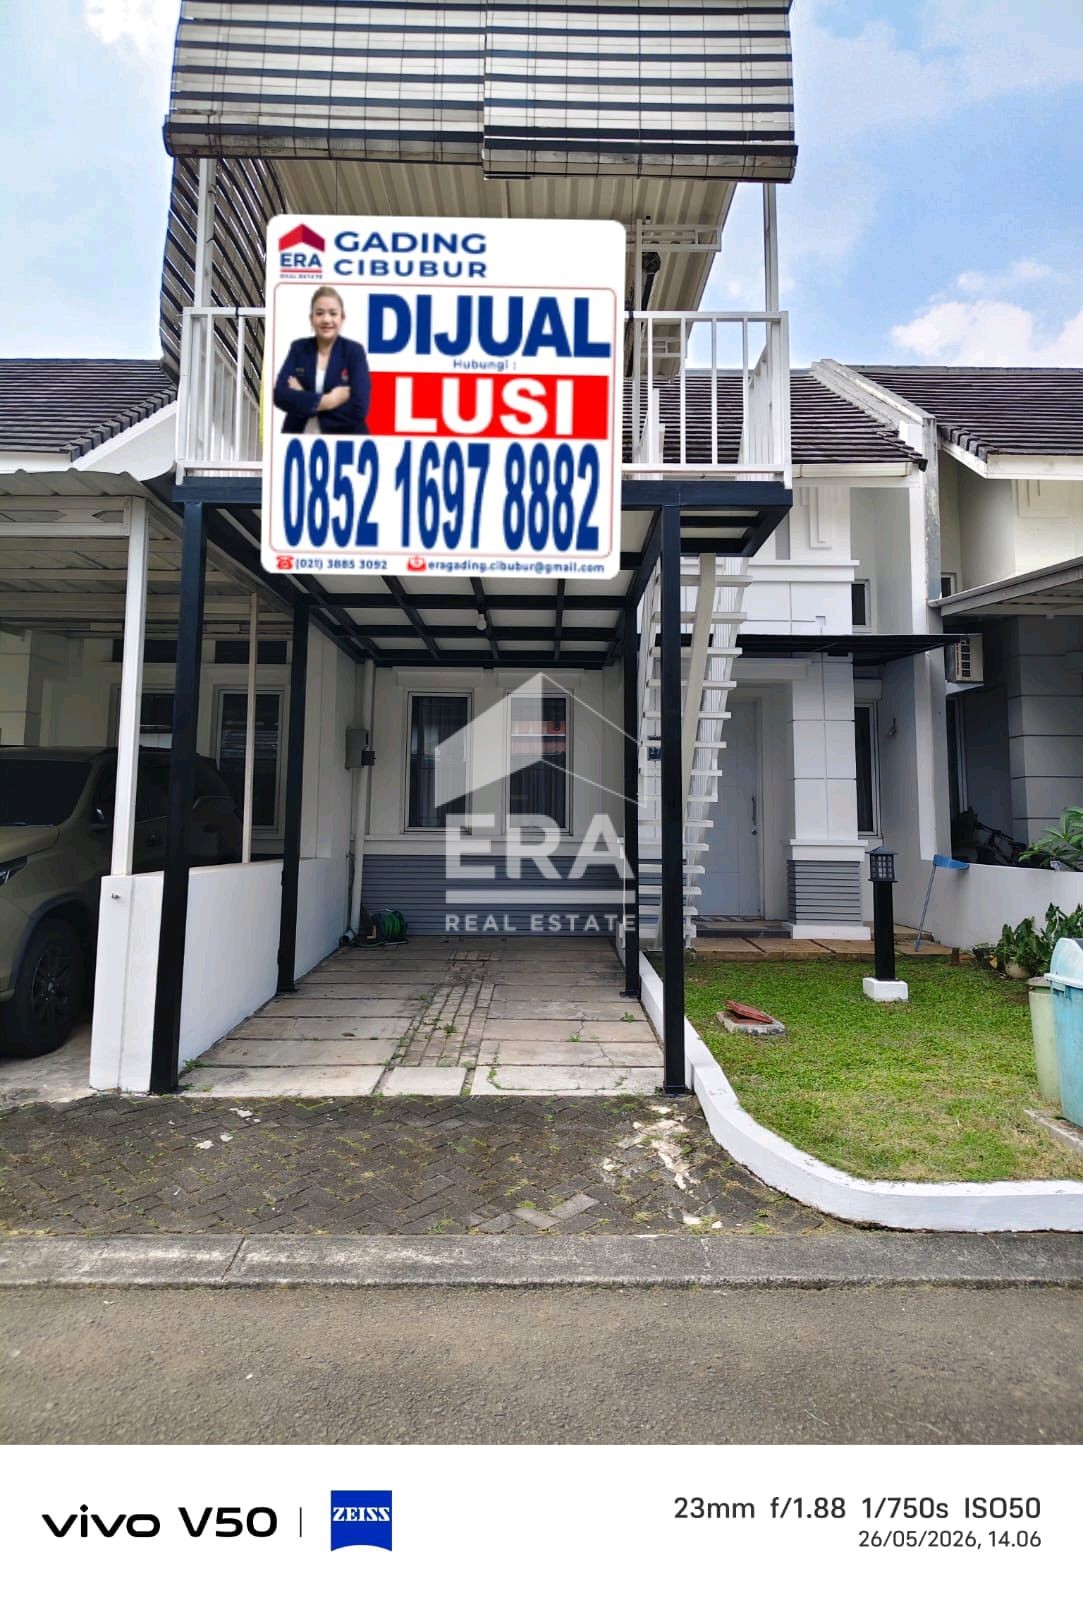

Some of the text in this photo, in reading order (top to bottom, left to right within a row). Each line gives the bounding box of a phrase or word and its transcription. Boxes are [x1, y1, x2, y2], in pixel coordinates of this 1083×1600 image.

[334, 230, 487, 254] GADING
[280, 252, 322, 267] ERA
[333, 258, 487, 278] CIBUBUR
[368, 293, 611, 358] DIJUAL
[453, 359, 509, 371] Hubungi
[394, 376, 574, 436] LUSI
[283, 438, 600, 551] 0852 1697 8882
[295, 557, 388, 570] (021) 3885 3092
